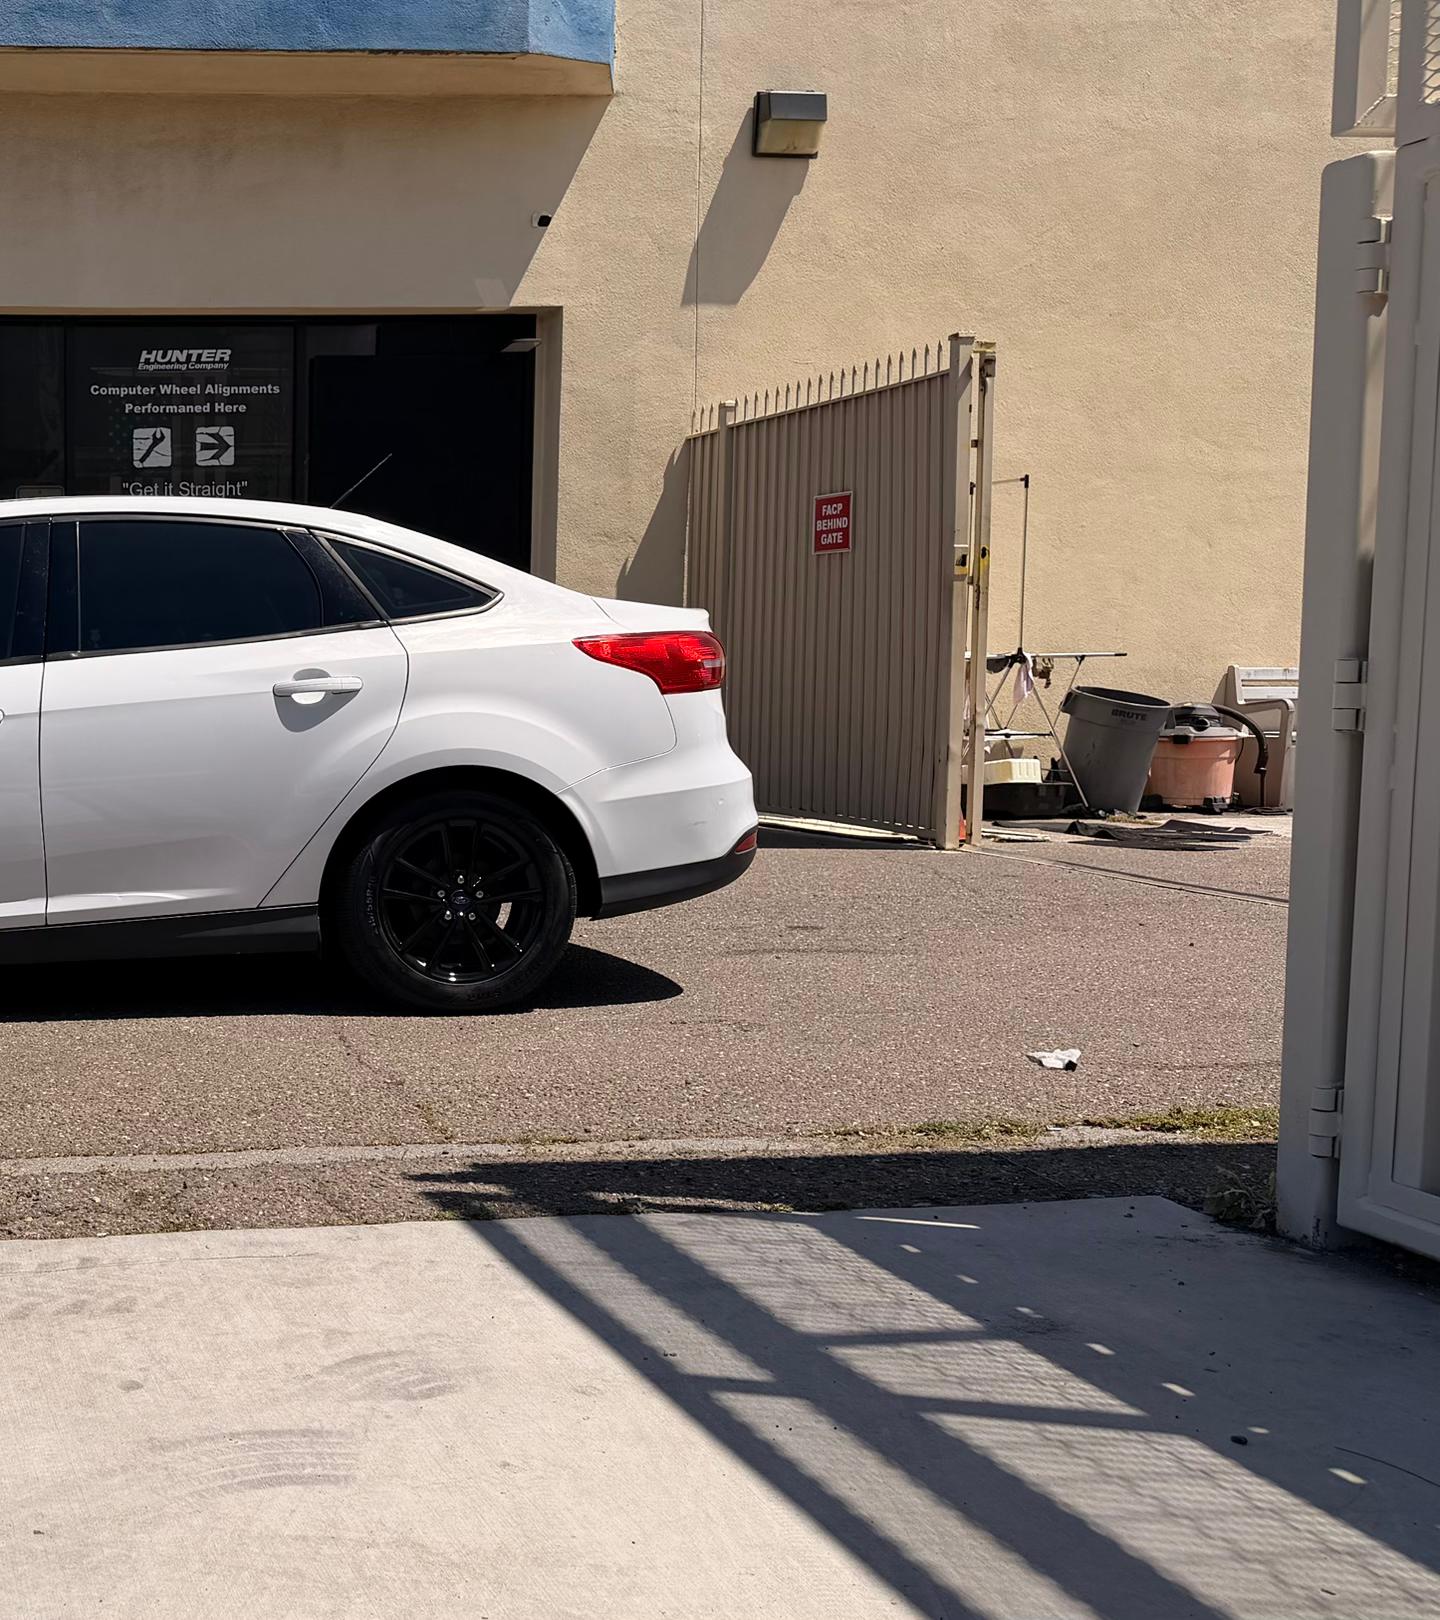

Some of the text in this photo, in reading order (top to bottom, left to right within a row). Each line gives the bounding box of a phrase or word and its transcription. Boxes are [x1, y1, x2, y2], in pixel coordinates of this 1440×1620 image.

[139, 349, 232, 363] HUNTER
[138, 362, 229, 371] Engineering Company
[90, 383, 281, 396] Computer Wheel Alignments
[125, 402, 247, 414] Performaned Here
[122, 480, 248, 498] "Get it Straight"
[822, 503, 843, 516] FACP
[816, 517, 848, 531] BEHIND
[821, 532, 843, 545] GATE
[1111, 709, 1147, 721] BRUTE
